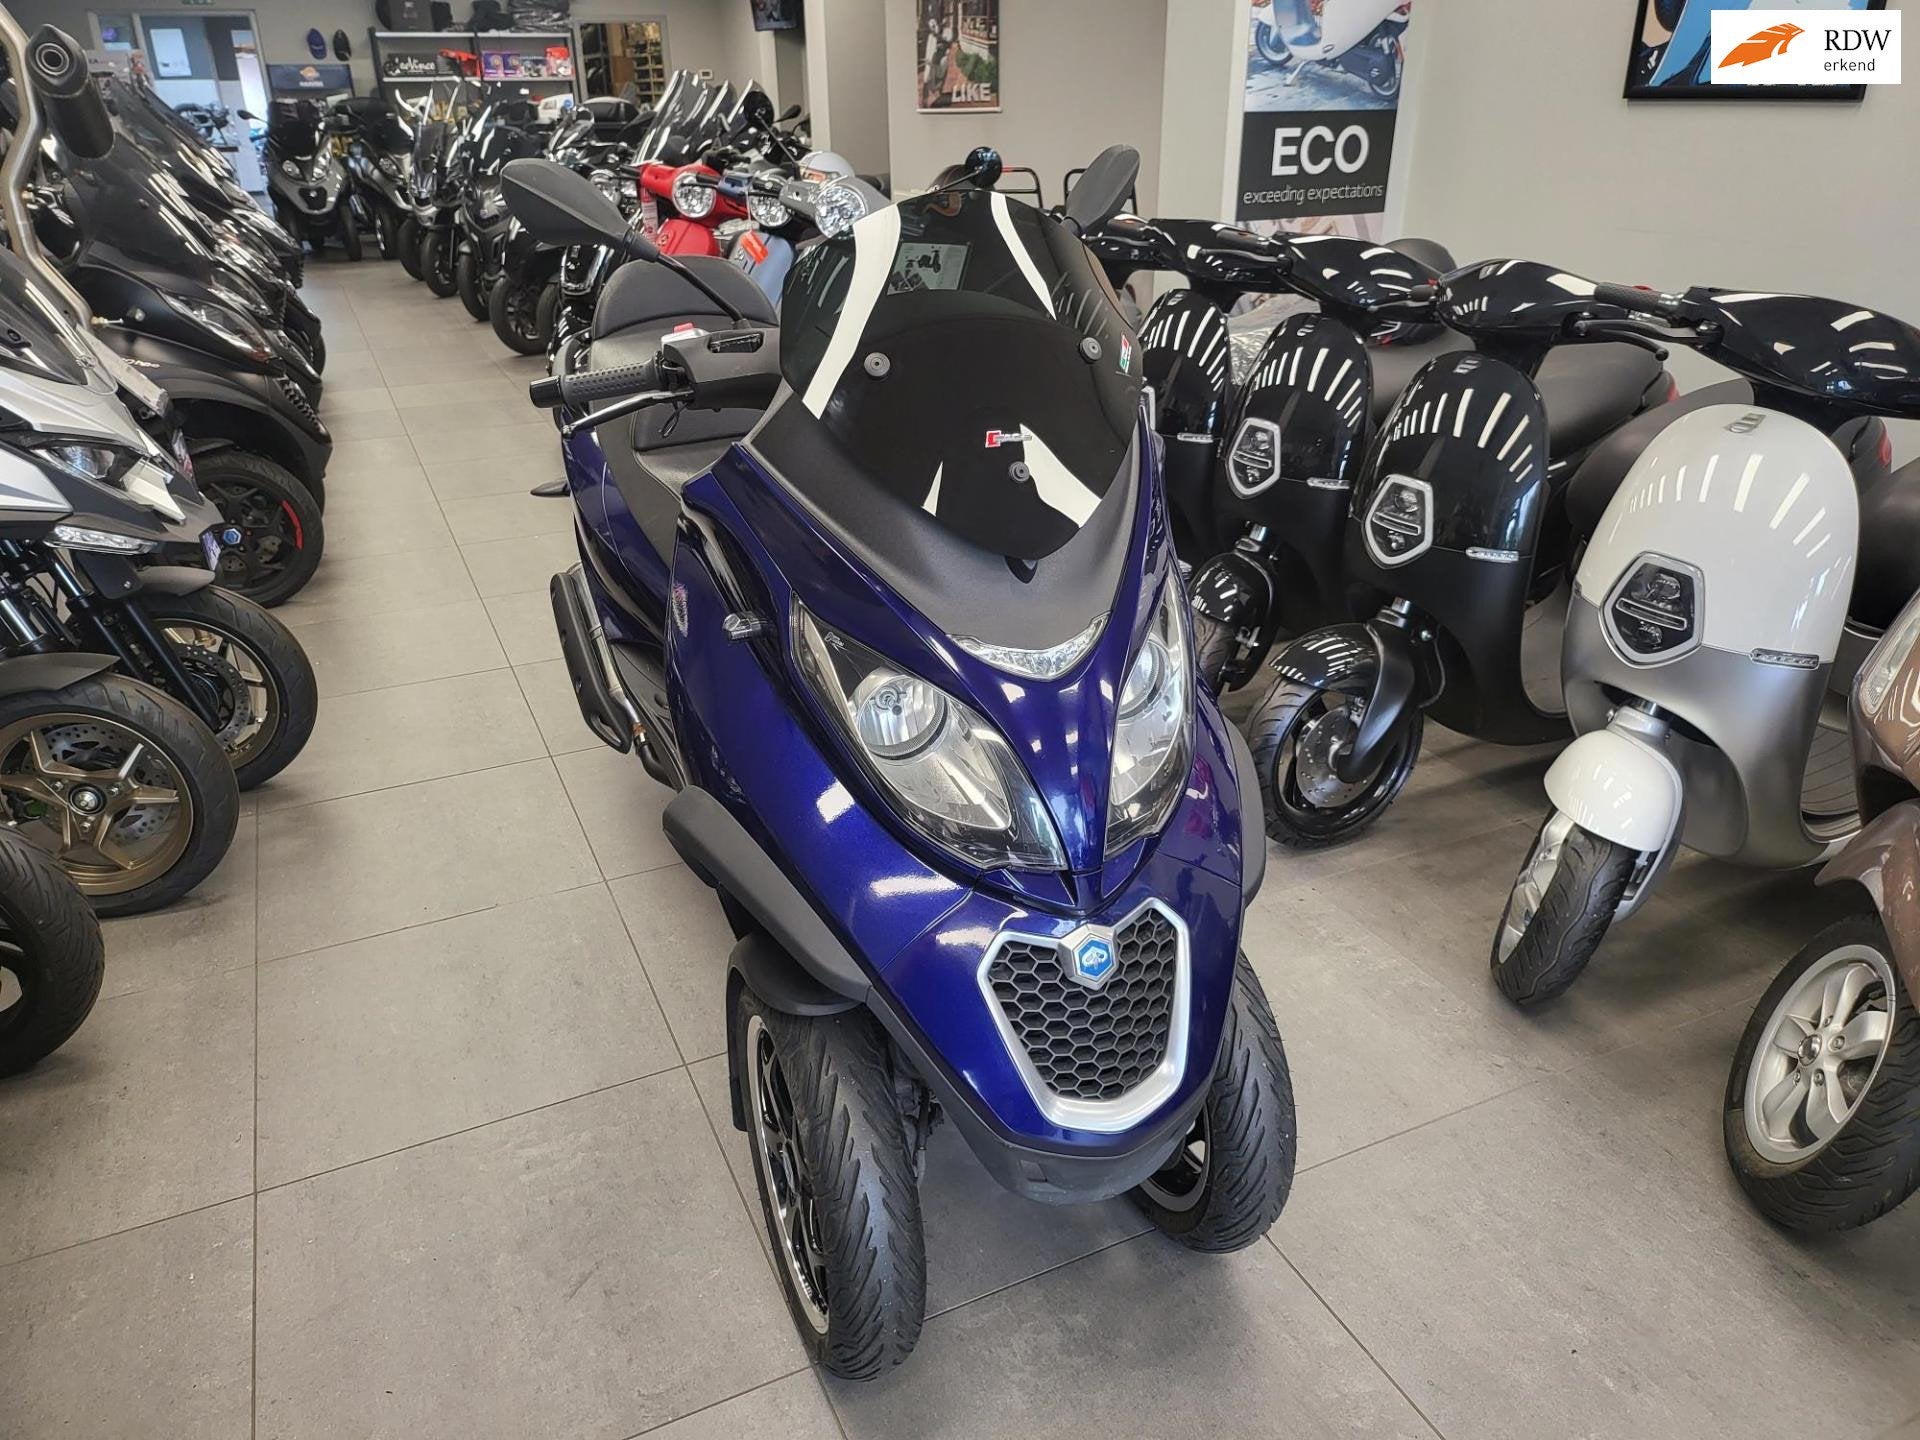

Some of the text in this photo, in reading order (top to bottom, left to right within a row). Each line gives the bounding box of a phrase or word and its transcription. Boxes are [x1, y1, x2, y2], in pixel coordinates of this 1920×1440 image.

[951, 82, 992, 103] LIKE
[1271, 124, 1370, 176] ECO
[1243, 183, 1384, 205] exceeding expectations
